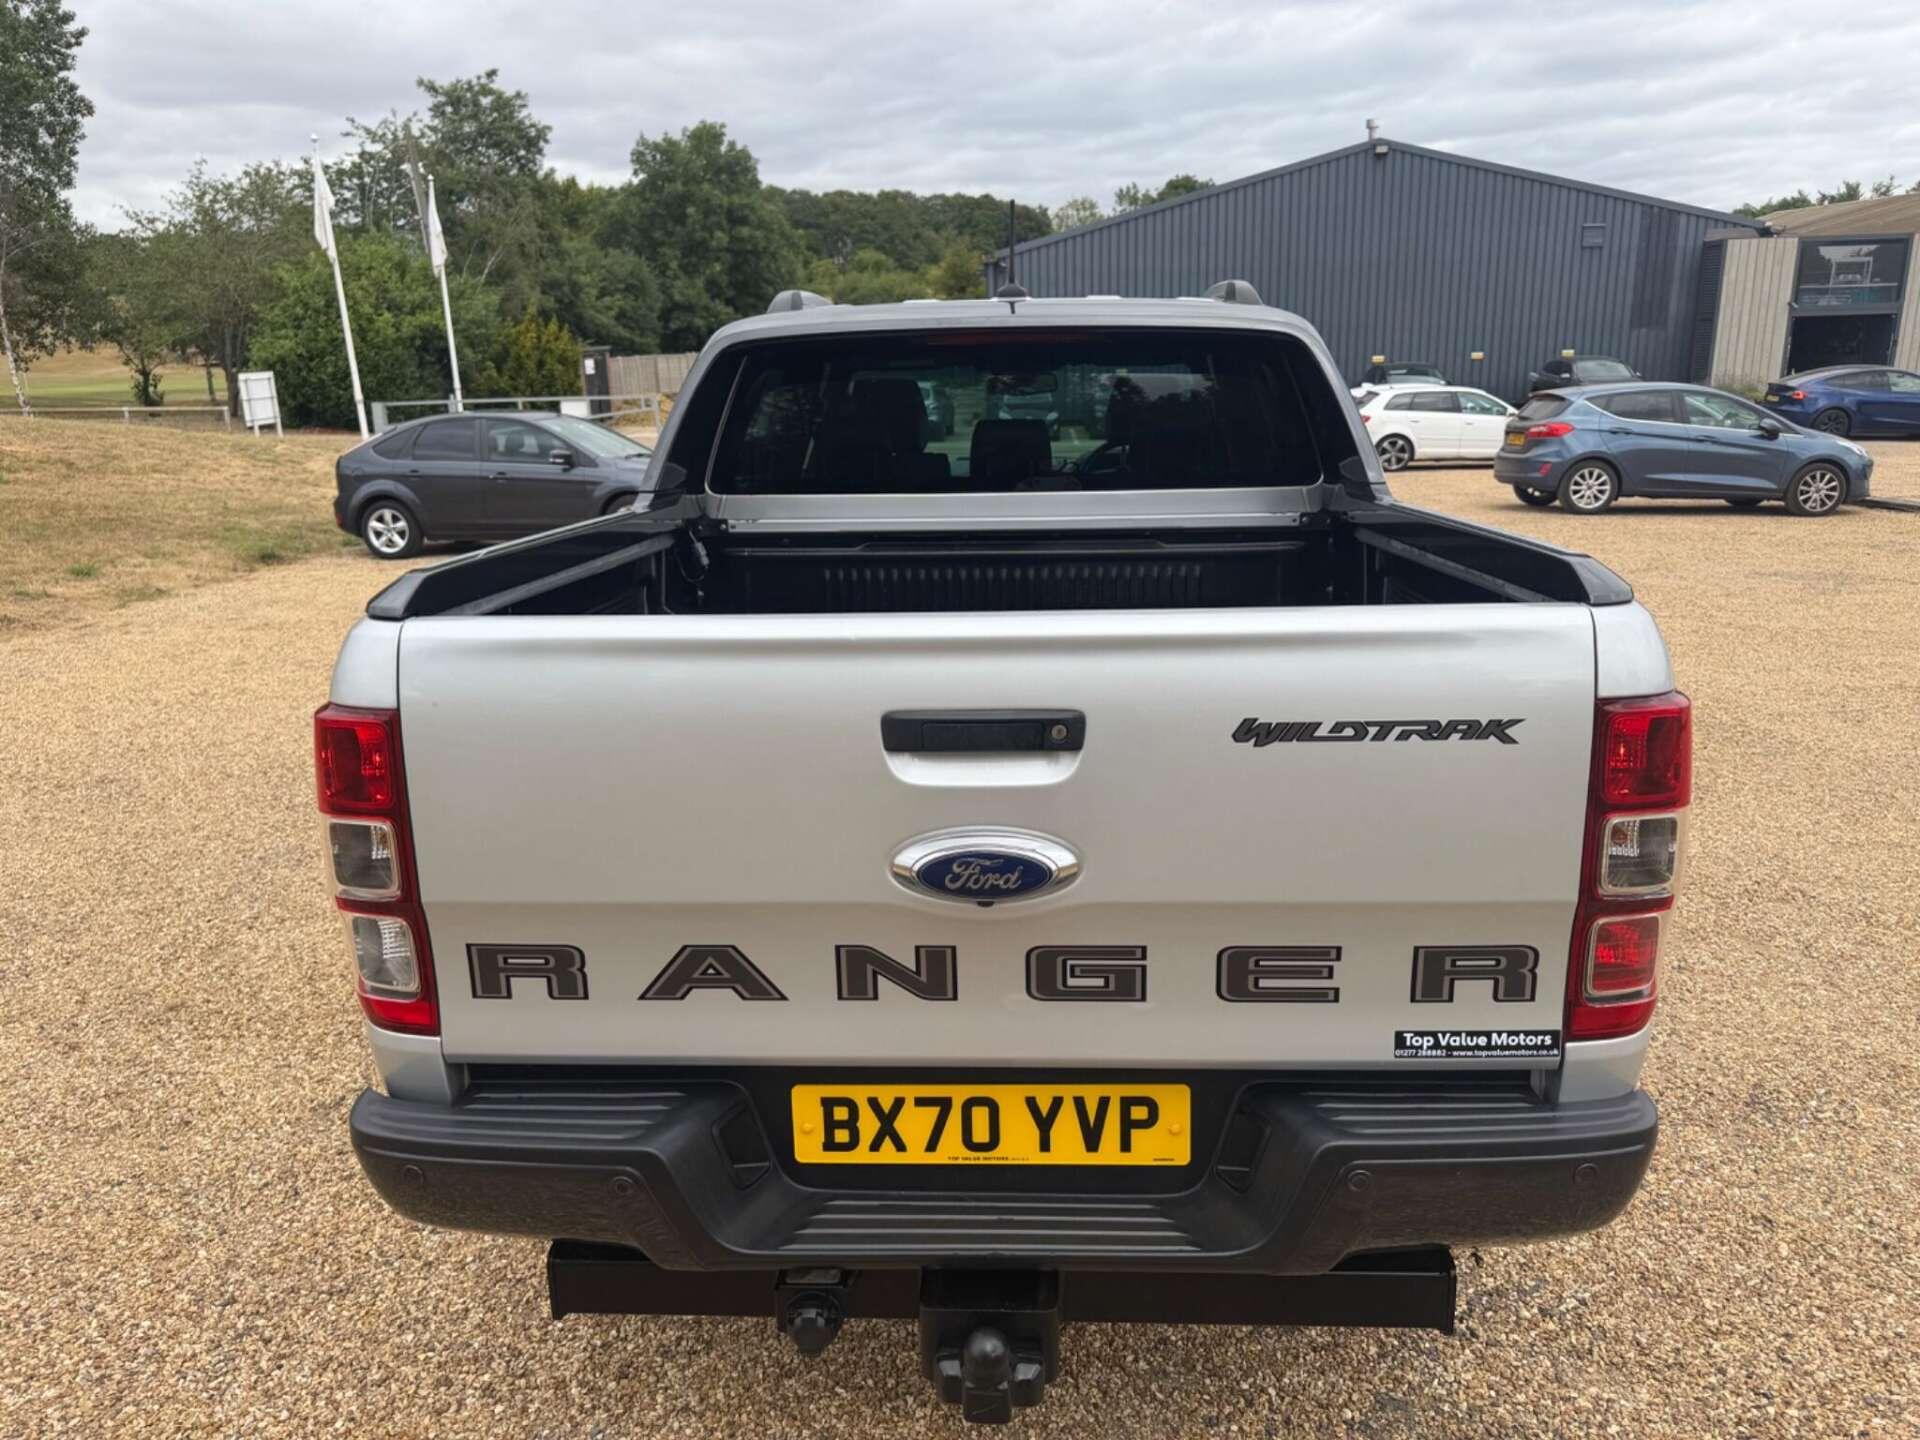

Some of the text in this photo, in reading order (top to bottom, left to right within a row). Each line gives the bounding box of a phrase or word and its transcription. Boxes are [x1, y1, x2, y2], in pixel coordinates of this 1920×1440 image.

[1231, 717, 1526, 747] WILDTRAK
[944, 857, 1023, 890] Ford
[465, 943, 1540, 1003] RANGER
[1403, 1032, 1552, 1050] Top Value Motors
[1453, 1048, 1558, 1057] www.topvaluemotors.co.uk
[820, 1096, 1160, 1152] BX70 YVP
